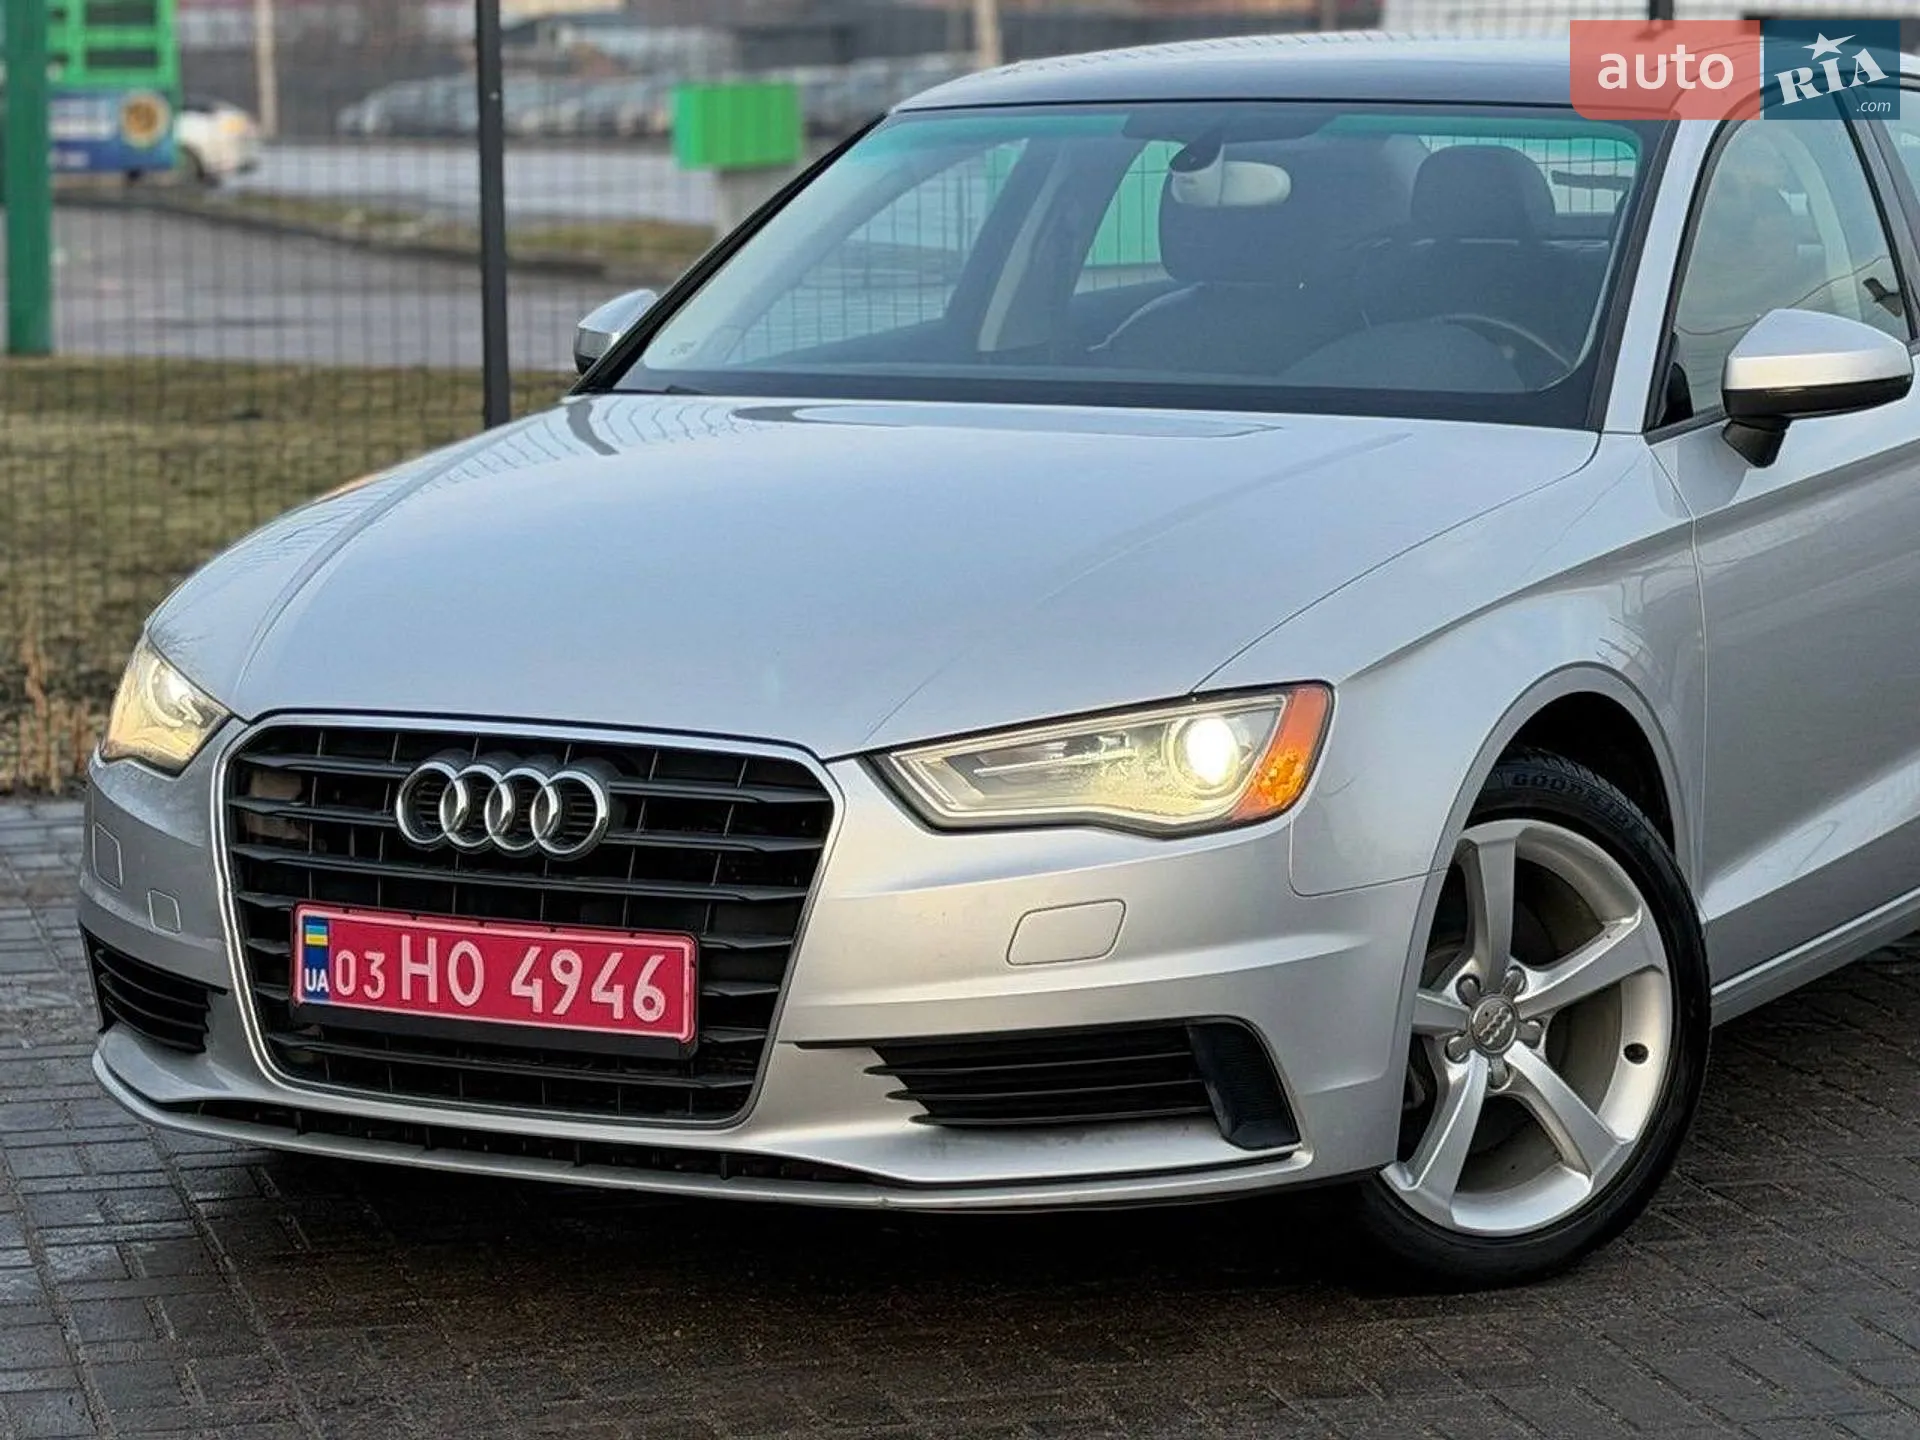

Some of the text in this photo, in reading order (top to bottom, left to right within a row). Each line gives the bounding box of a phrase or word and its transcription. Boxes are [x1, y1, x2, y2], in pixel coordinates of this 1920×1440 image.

[305, 968, 329, 993] UA
[335, 934, 666, 1022] 03 HO 4946
